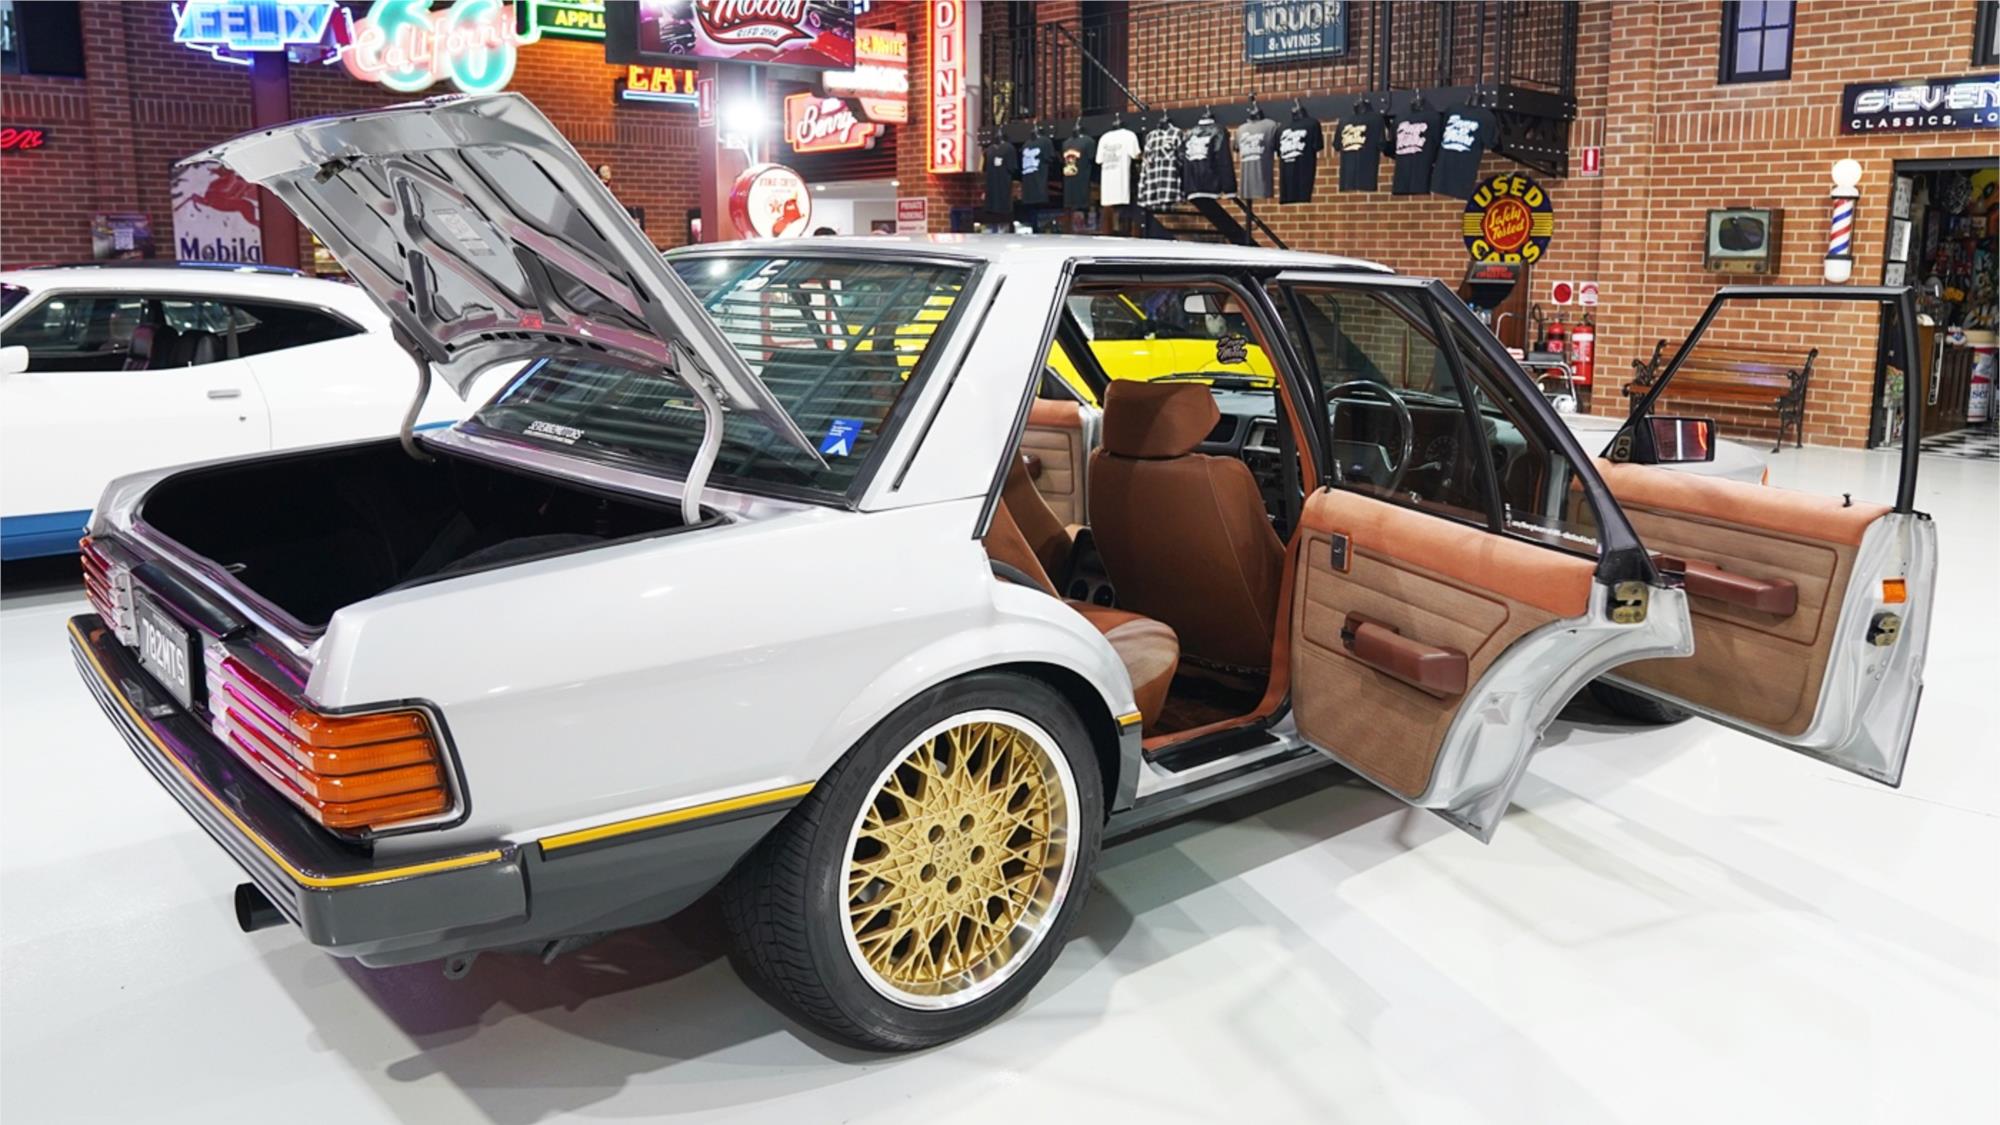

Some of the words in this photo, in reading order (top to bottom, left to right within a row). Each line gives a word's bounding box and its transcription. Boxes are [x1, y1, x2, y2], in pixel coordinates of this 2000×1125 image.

[194, 4, 319, 41] FELIX
[1268, 37, 1280, 51] &
[1280, 33, 1322, 49] WINES
[935, 2, 957, 165] DINER
[1851, 115, 1957, 129] CLASSICS,
[1473, 176, 1544, 208] USED
[1489, 206, 1522, 229] Safety
[1492, 218, 1526, 241] Tested
[1471, 239, 1541, 264] CARS
